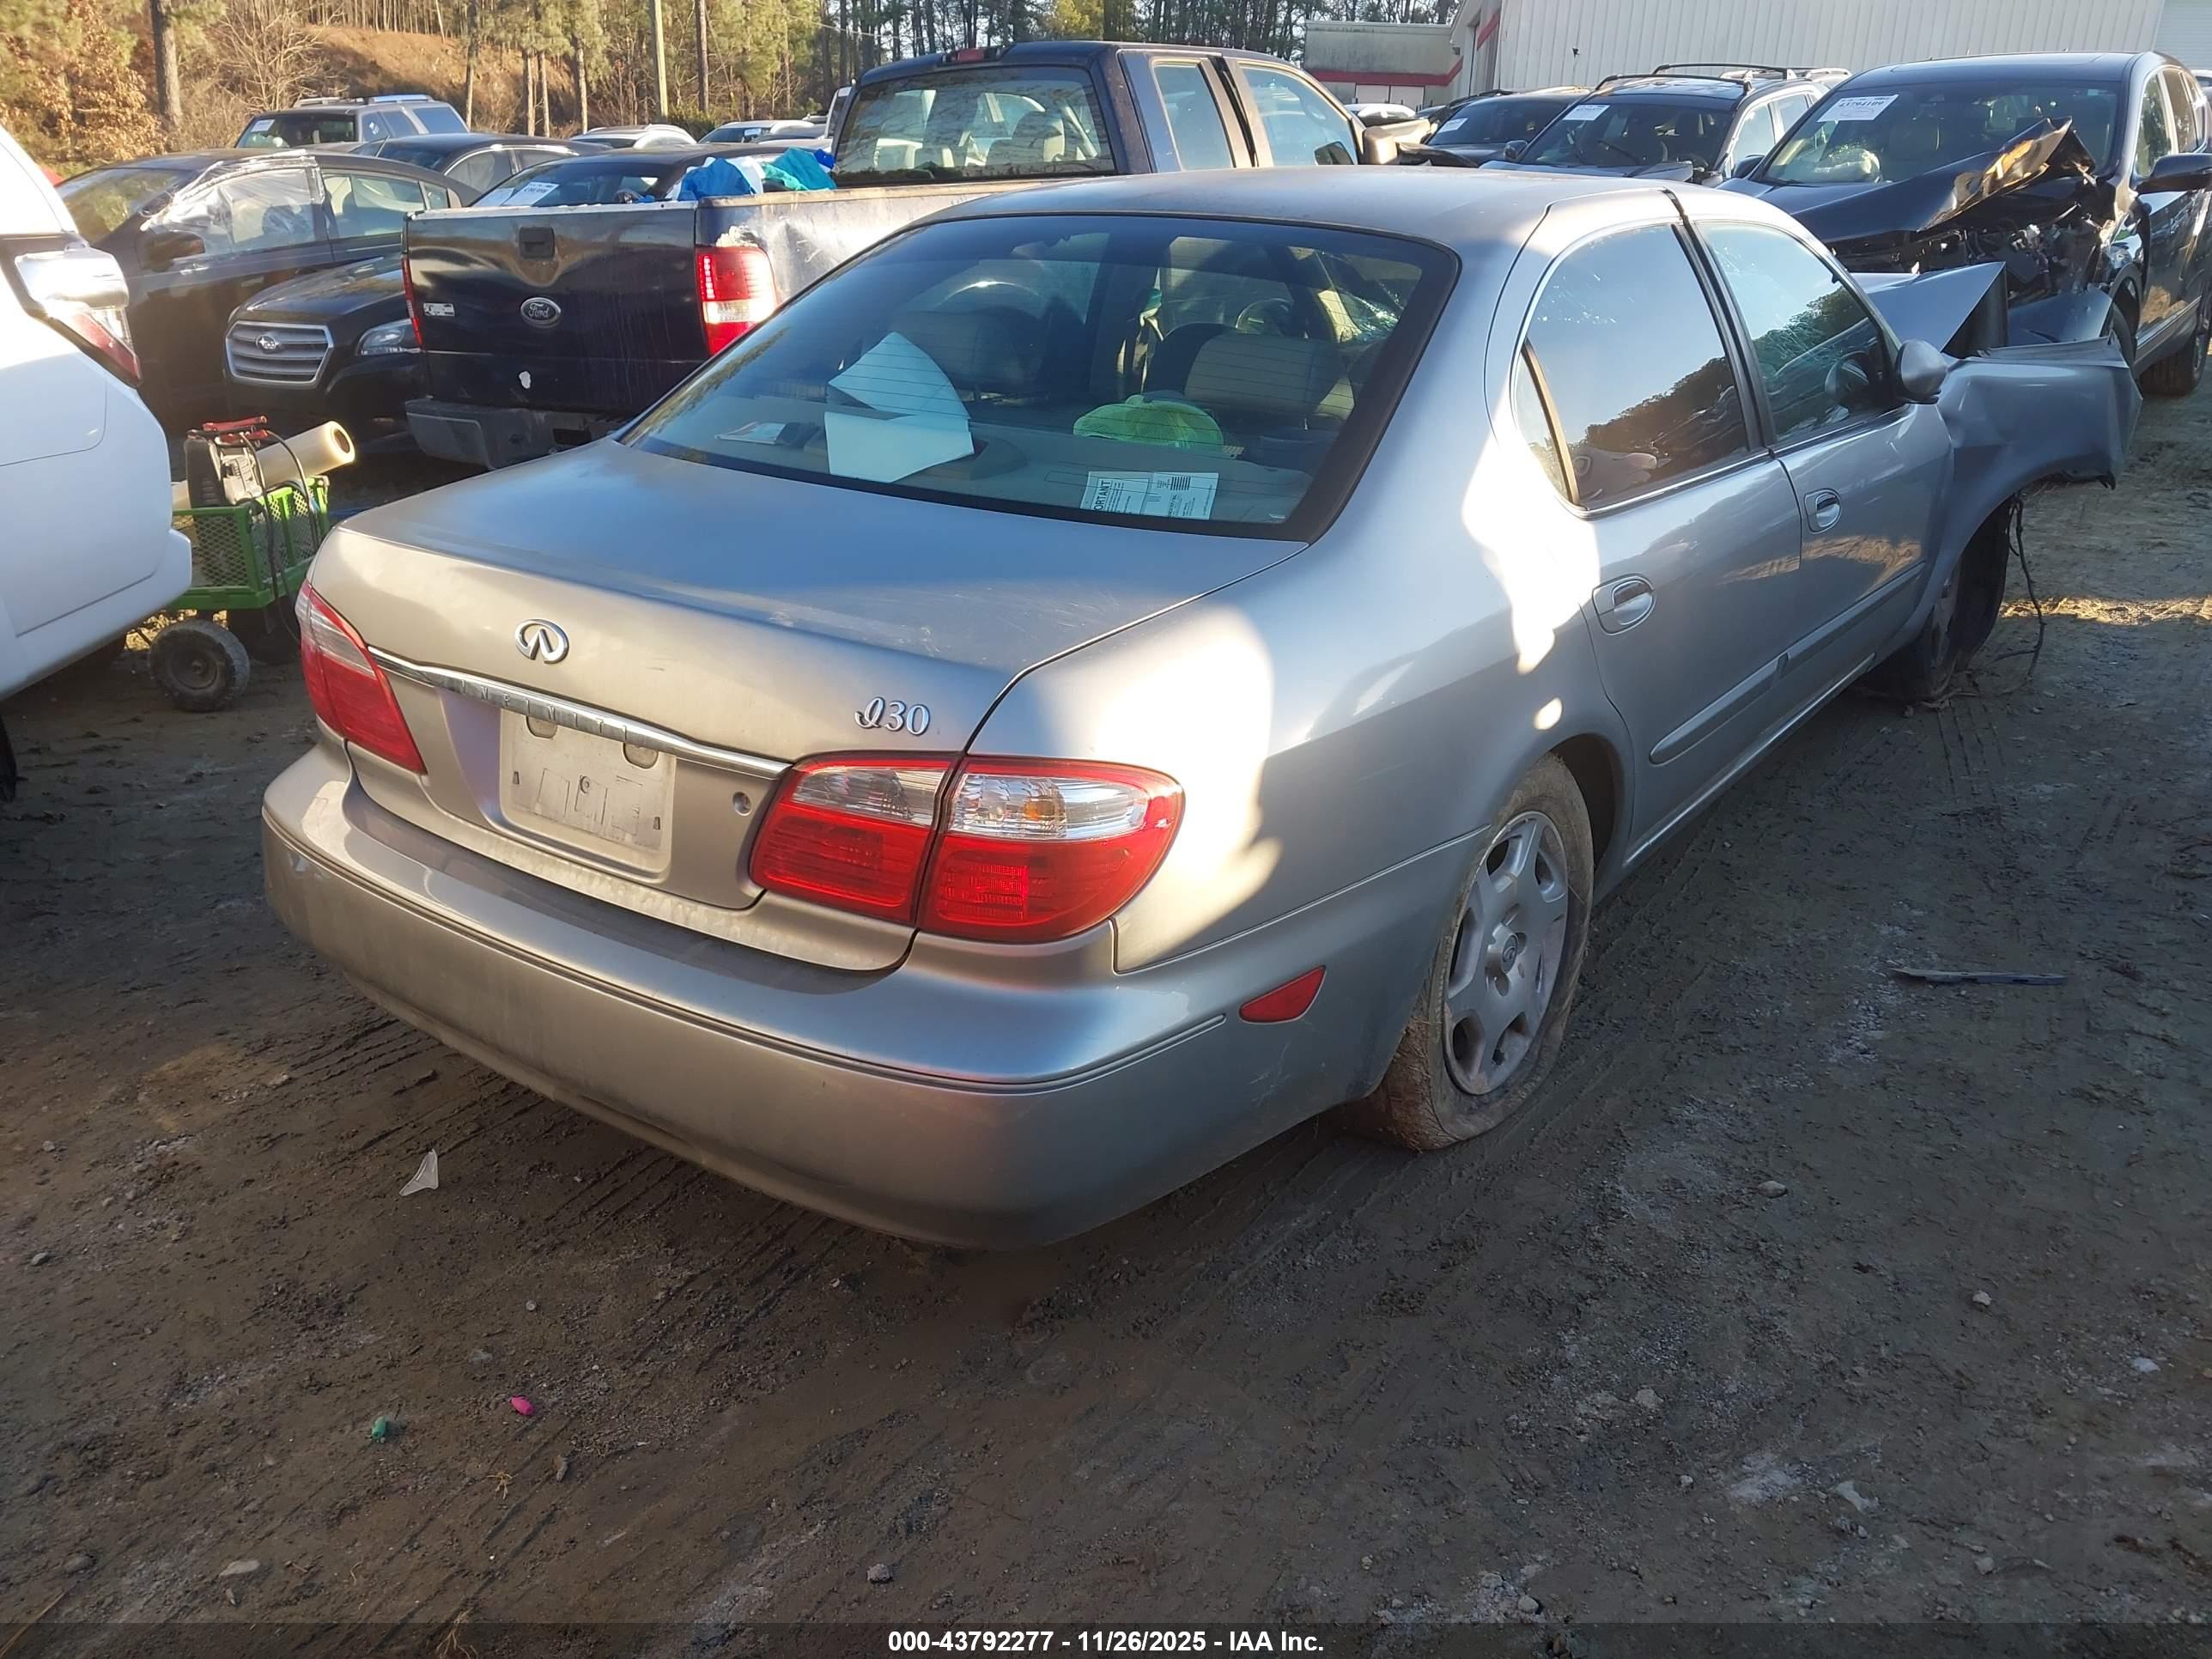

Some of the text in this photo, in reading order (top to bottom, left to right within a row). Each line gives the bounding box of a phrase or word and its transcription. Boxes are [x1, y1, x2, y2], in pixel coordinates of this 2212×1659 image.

[527, 302, 550, 319] Ford
[460, 679, 628, 742] INFINITI
[854, 696, 931, 736] I30
